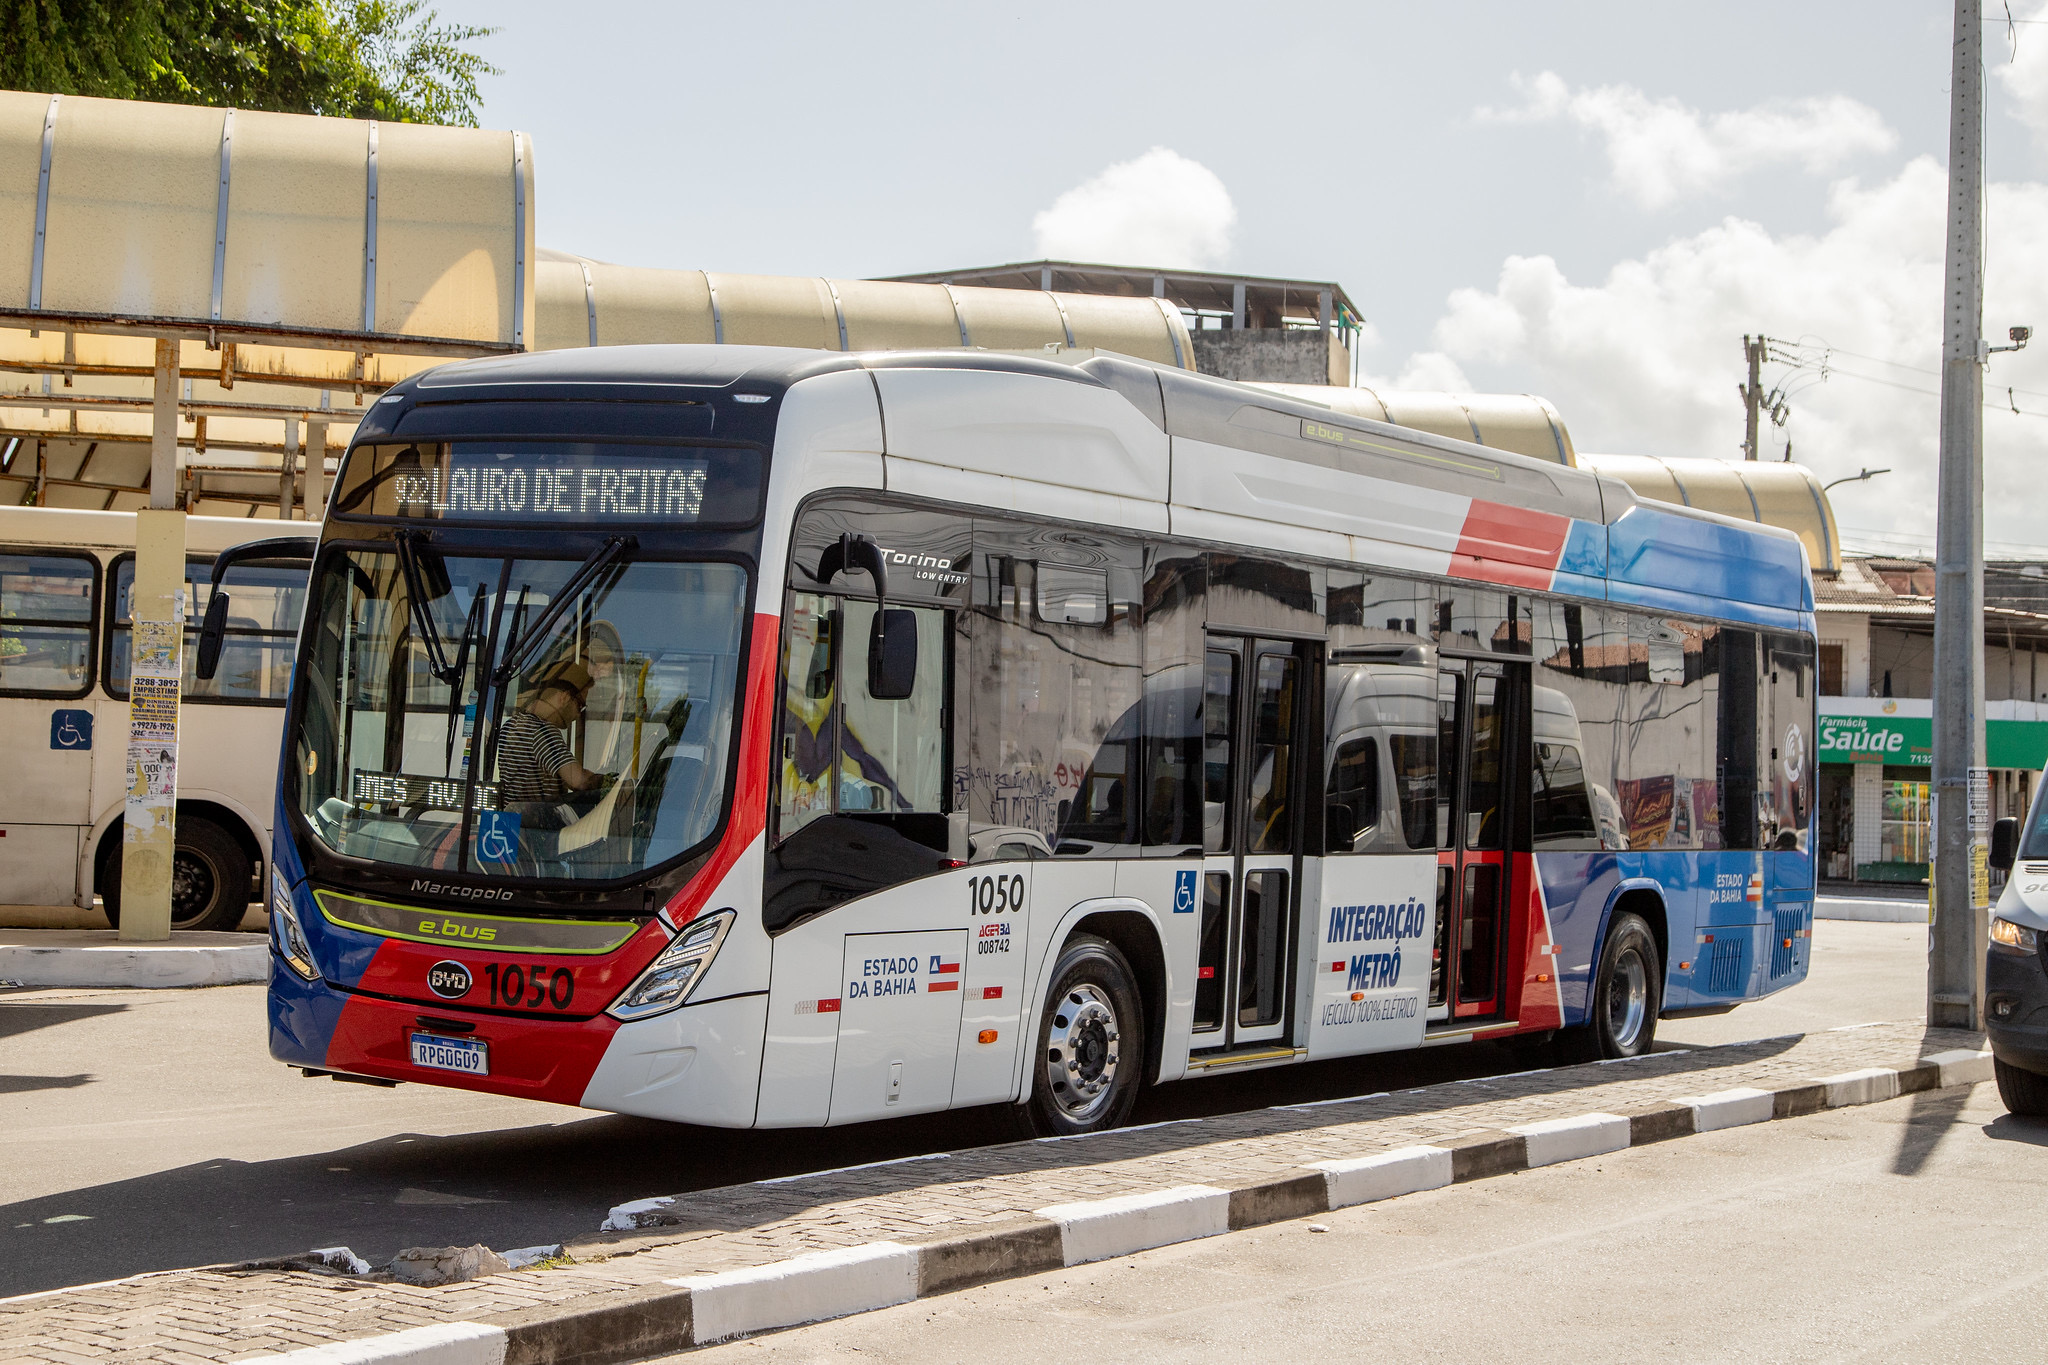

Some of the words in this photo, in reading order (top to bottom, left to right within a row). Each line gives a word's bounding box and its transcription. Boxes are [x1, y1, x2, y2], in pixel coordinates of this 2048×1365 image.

[1306, 424, 1344, 442] e.bus
[395, 476, 430, 503] 922
[432, 467, 526, 511] LAURO
[534, 468, 573, 512] DE
[580, 468, 707, 514] FREITAS
[880, 548, 951, 569] Torino
[916, 571, 936, 580] LOW
[938, 573, 967, 584] ENTRY
[136, 722, 175, 730] 99276-1926
[1820, 716, 1867, 728] Farmácia
[1820, 727, 1904, 752] Saúde
[1849, 751, 1884, 762] Bahia
[410, 879, 514, 900] Marcopolo
[1716, 872, 1743, 888] ESTADO
[968, 873, 1025, 916] 1050
[1710, 890, 1720, 904] DA
[1721, 889, 1742, 903] BAHIA
[418, 919, 497, 941] e.bus
[978, 922, 1011, 938] AGERBA
[1327, 896, 1426, 945] INTEGRAÇÃO
[978, 938, 1010, 955] 008742
[863, 956, 919, 977] ESTADO
[1347, 945, 1402, 991] METRÔ
[432, 970, 467, 990] BYD
[484, 962, 575, 1010] 1050
[850, 980, 869, 999] DA
[873, 977, 917, 997] BAHIA
[1322, 1000, 1356, 1026] VEÍCULO
[1356, 1000, 1382, 1023] 100%
[1382, 994, 1418, 1021] ELÉTRICO
